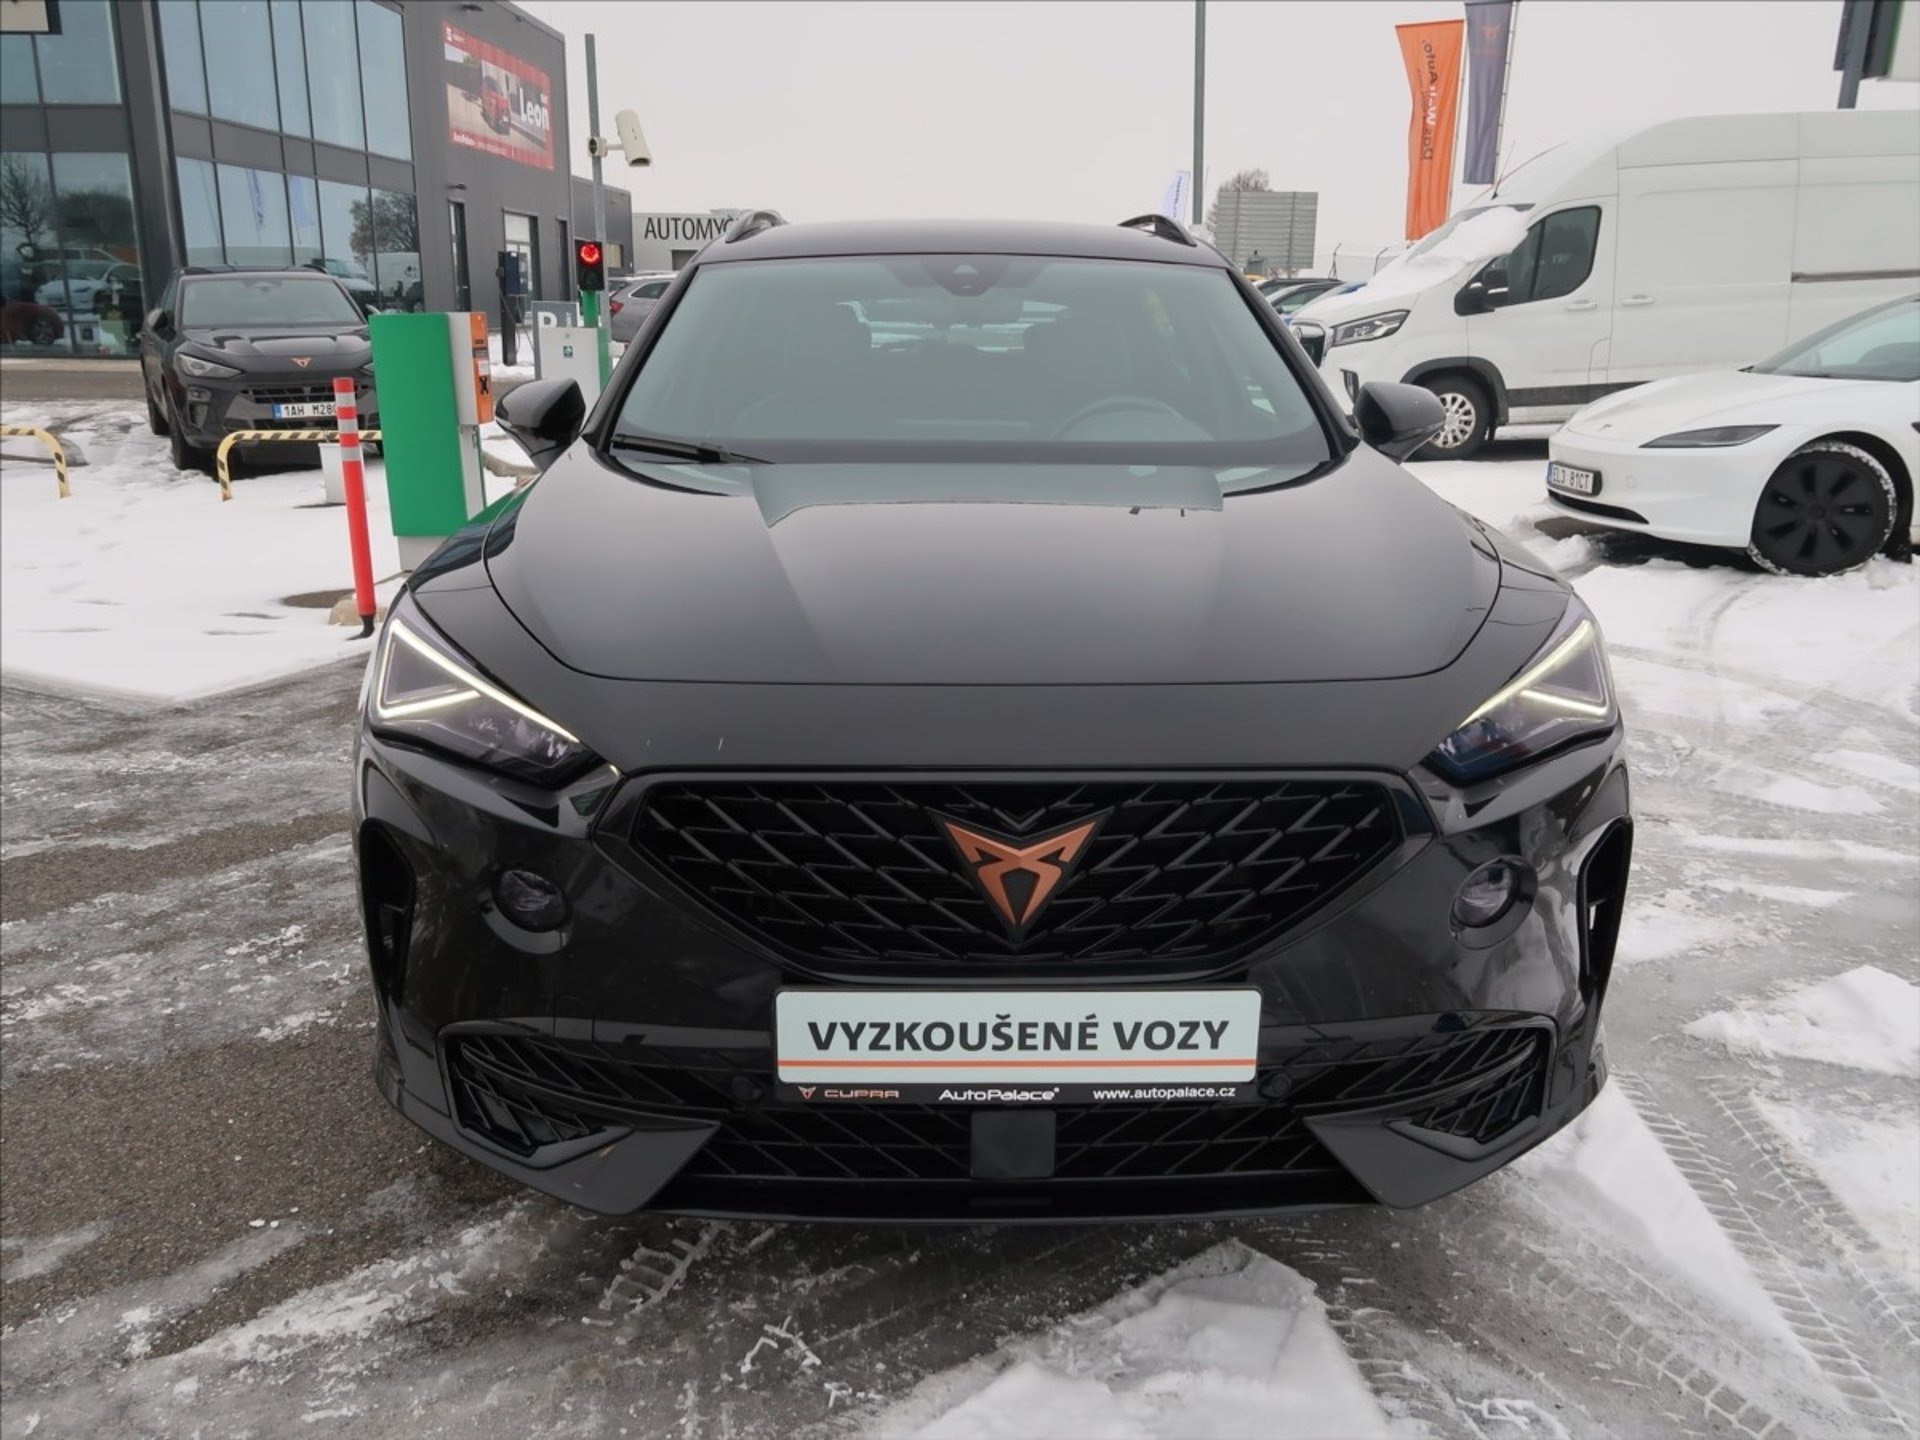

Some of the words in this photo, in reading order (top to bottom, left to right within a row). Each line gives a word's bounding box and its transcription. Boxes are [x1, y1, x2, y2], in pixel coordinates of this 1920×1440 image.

[519, 87, 550, 131] Leon
[284, 405, 304, 417] 1AH
[807, 1013, 1099, 1052] VYZKOUŠENÉ
[1112, 1020, 1230, 1051] VOZY
[824, 1088, 900, 1099] CUPRA
[1092, 1086, 1237, 1100] www.autopalace.cz
